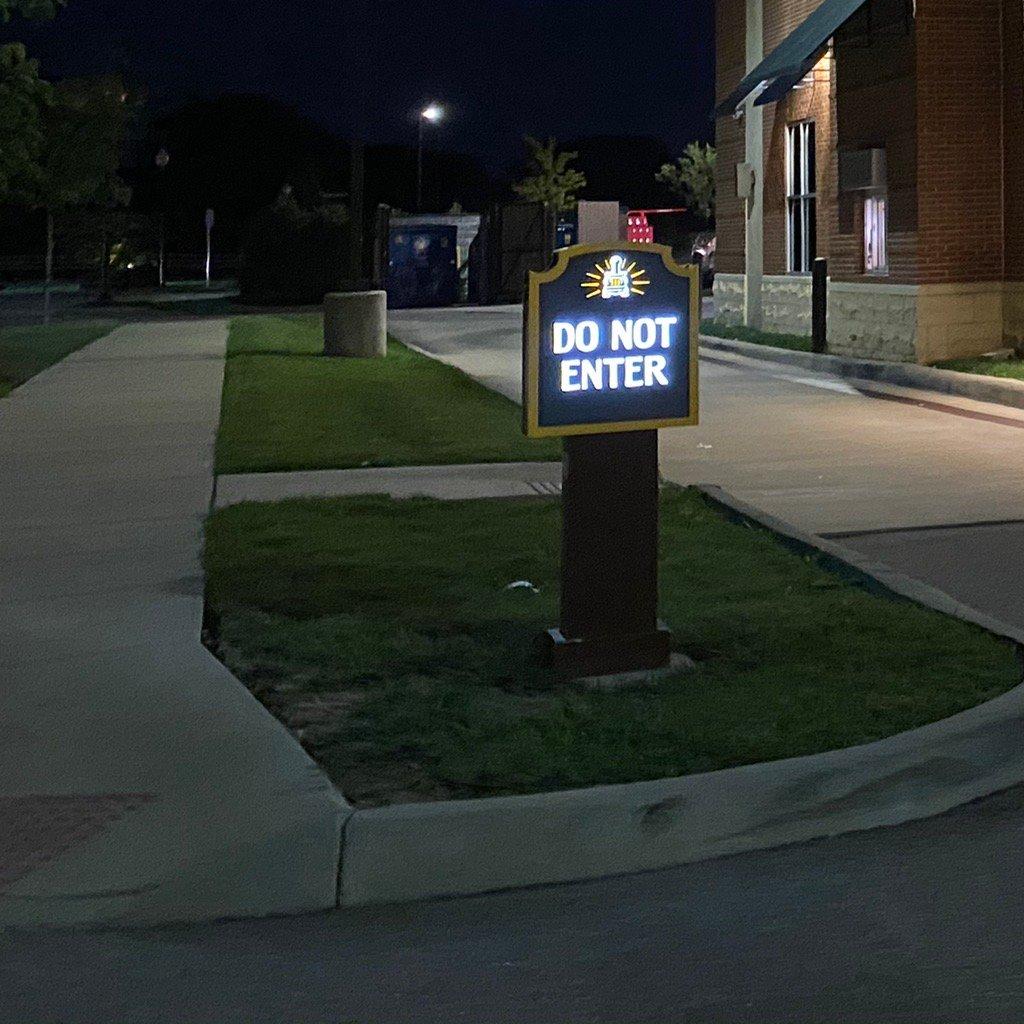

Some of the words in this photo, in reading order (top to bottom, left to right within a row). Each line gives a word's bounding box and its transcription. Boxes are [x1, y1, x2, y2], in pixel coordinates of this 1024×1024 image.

[553, 320, 599, 354] DO
[611, 317, 678, 351] NOT
[560, 354, 669, 392] ENTER
